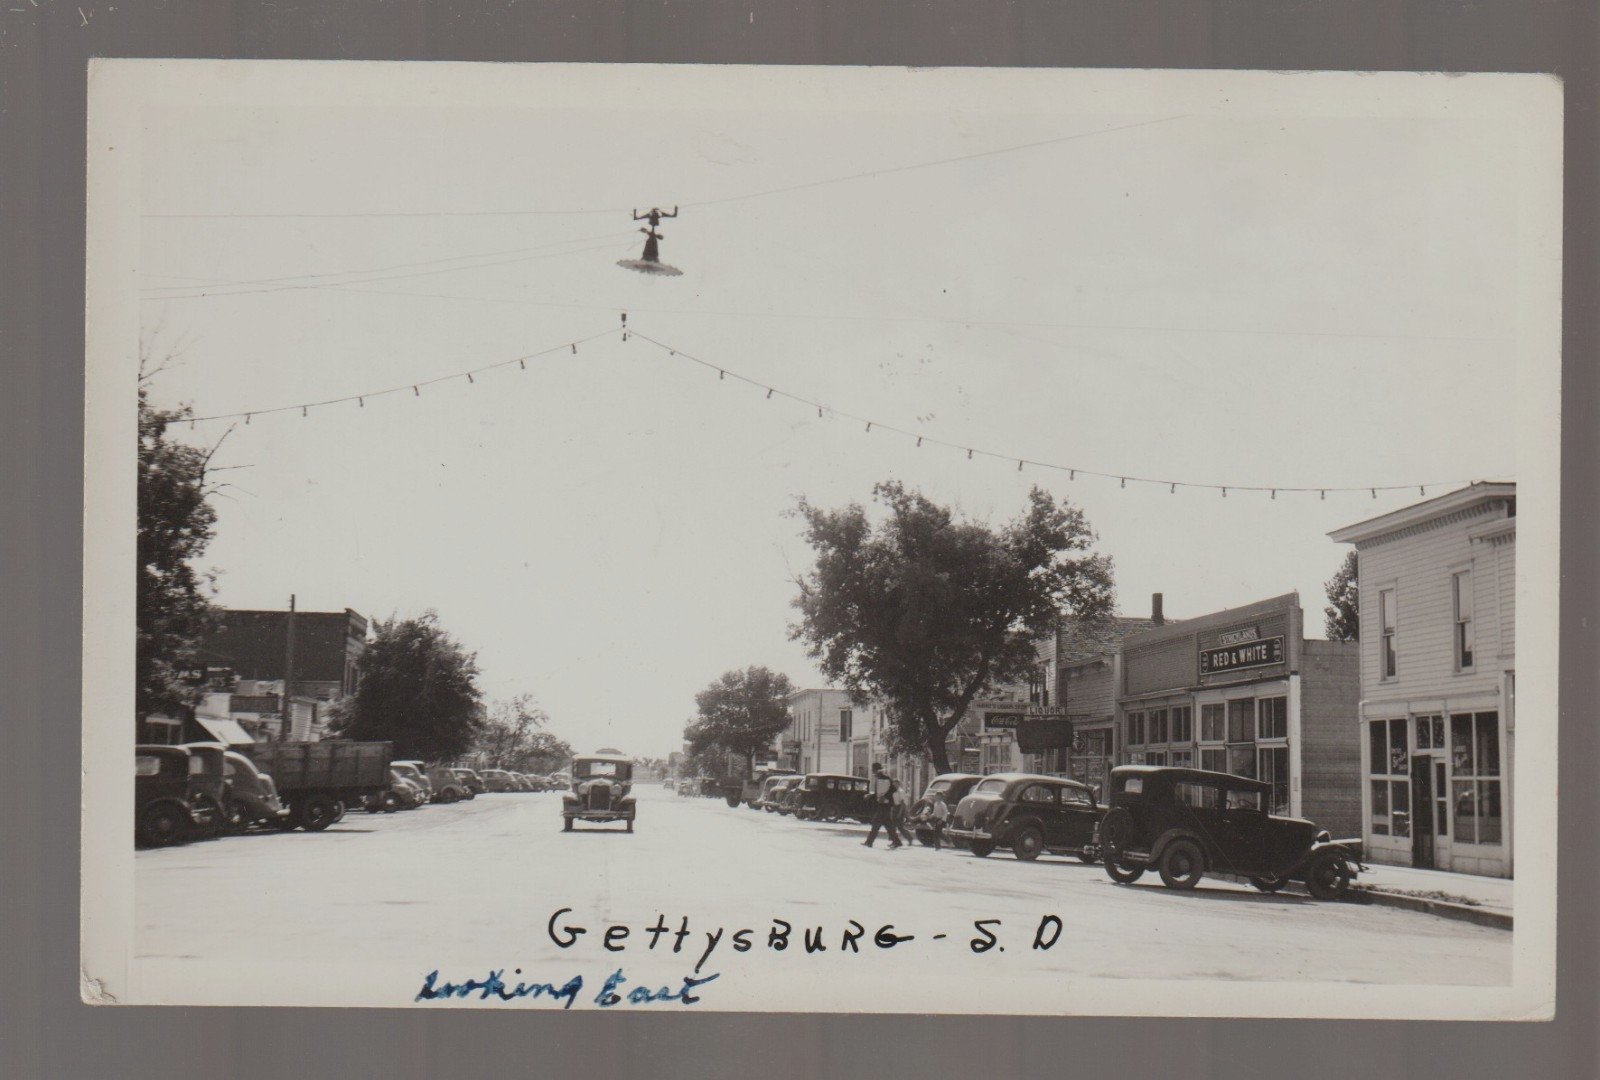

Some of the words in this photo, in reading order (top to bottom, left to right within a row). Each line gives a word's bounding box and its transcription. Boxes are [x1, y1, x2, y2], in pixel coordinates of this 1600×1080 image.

[1213, 652, 1230, 667] RED
[1231, 652, 1238, 665] &
[1239, 645, 1267, 663] WHITE
[1029, 706, 1061, 715] LIQUOR
[1032, 914, 1063, 951] D
